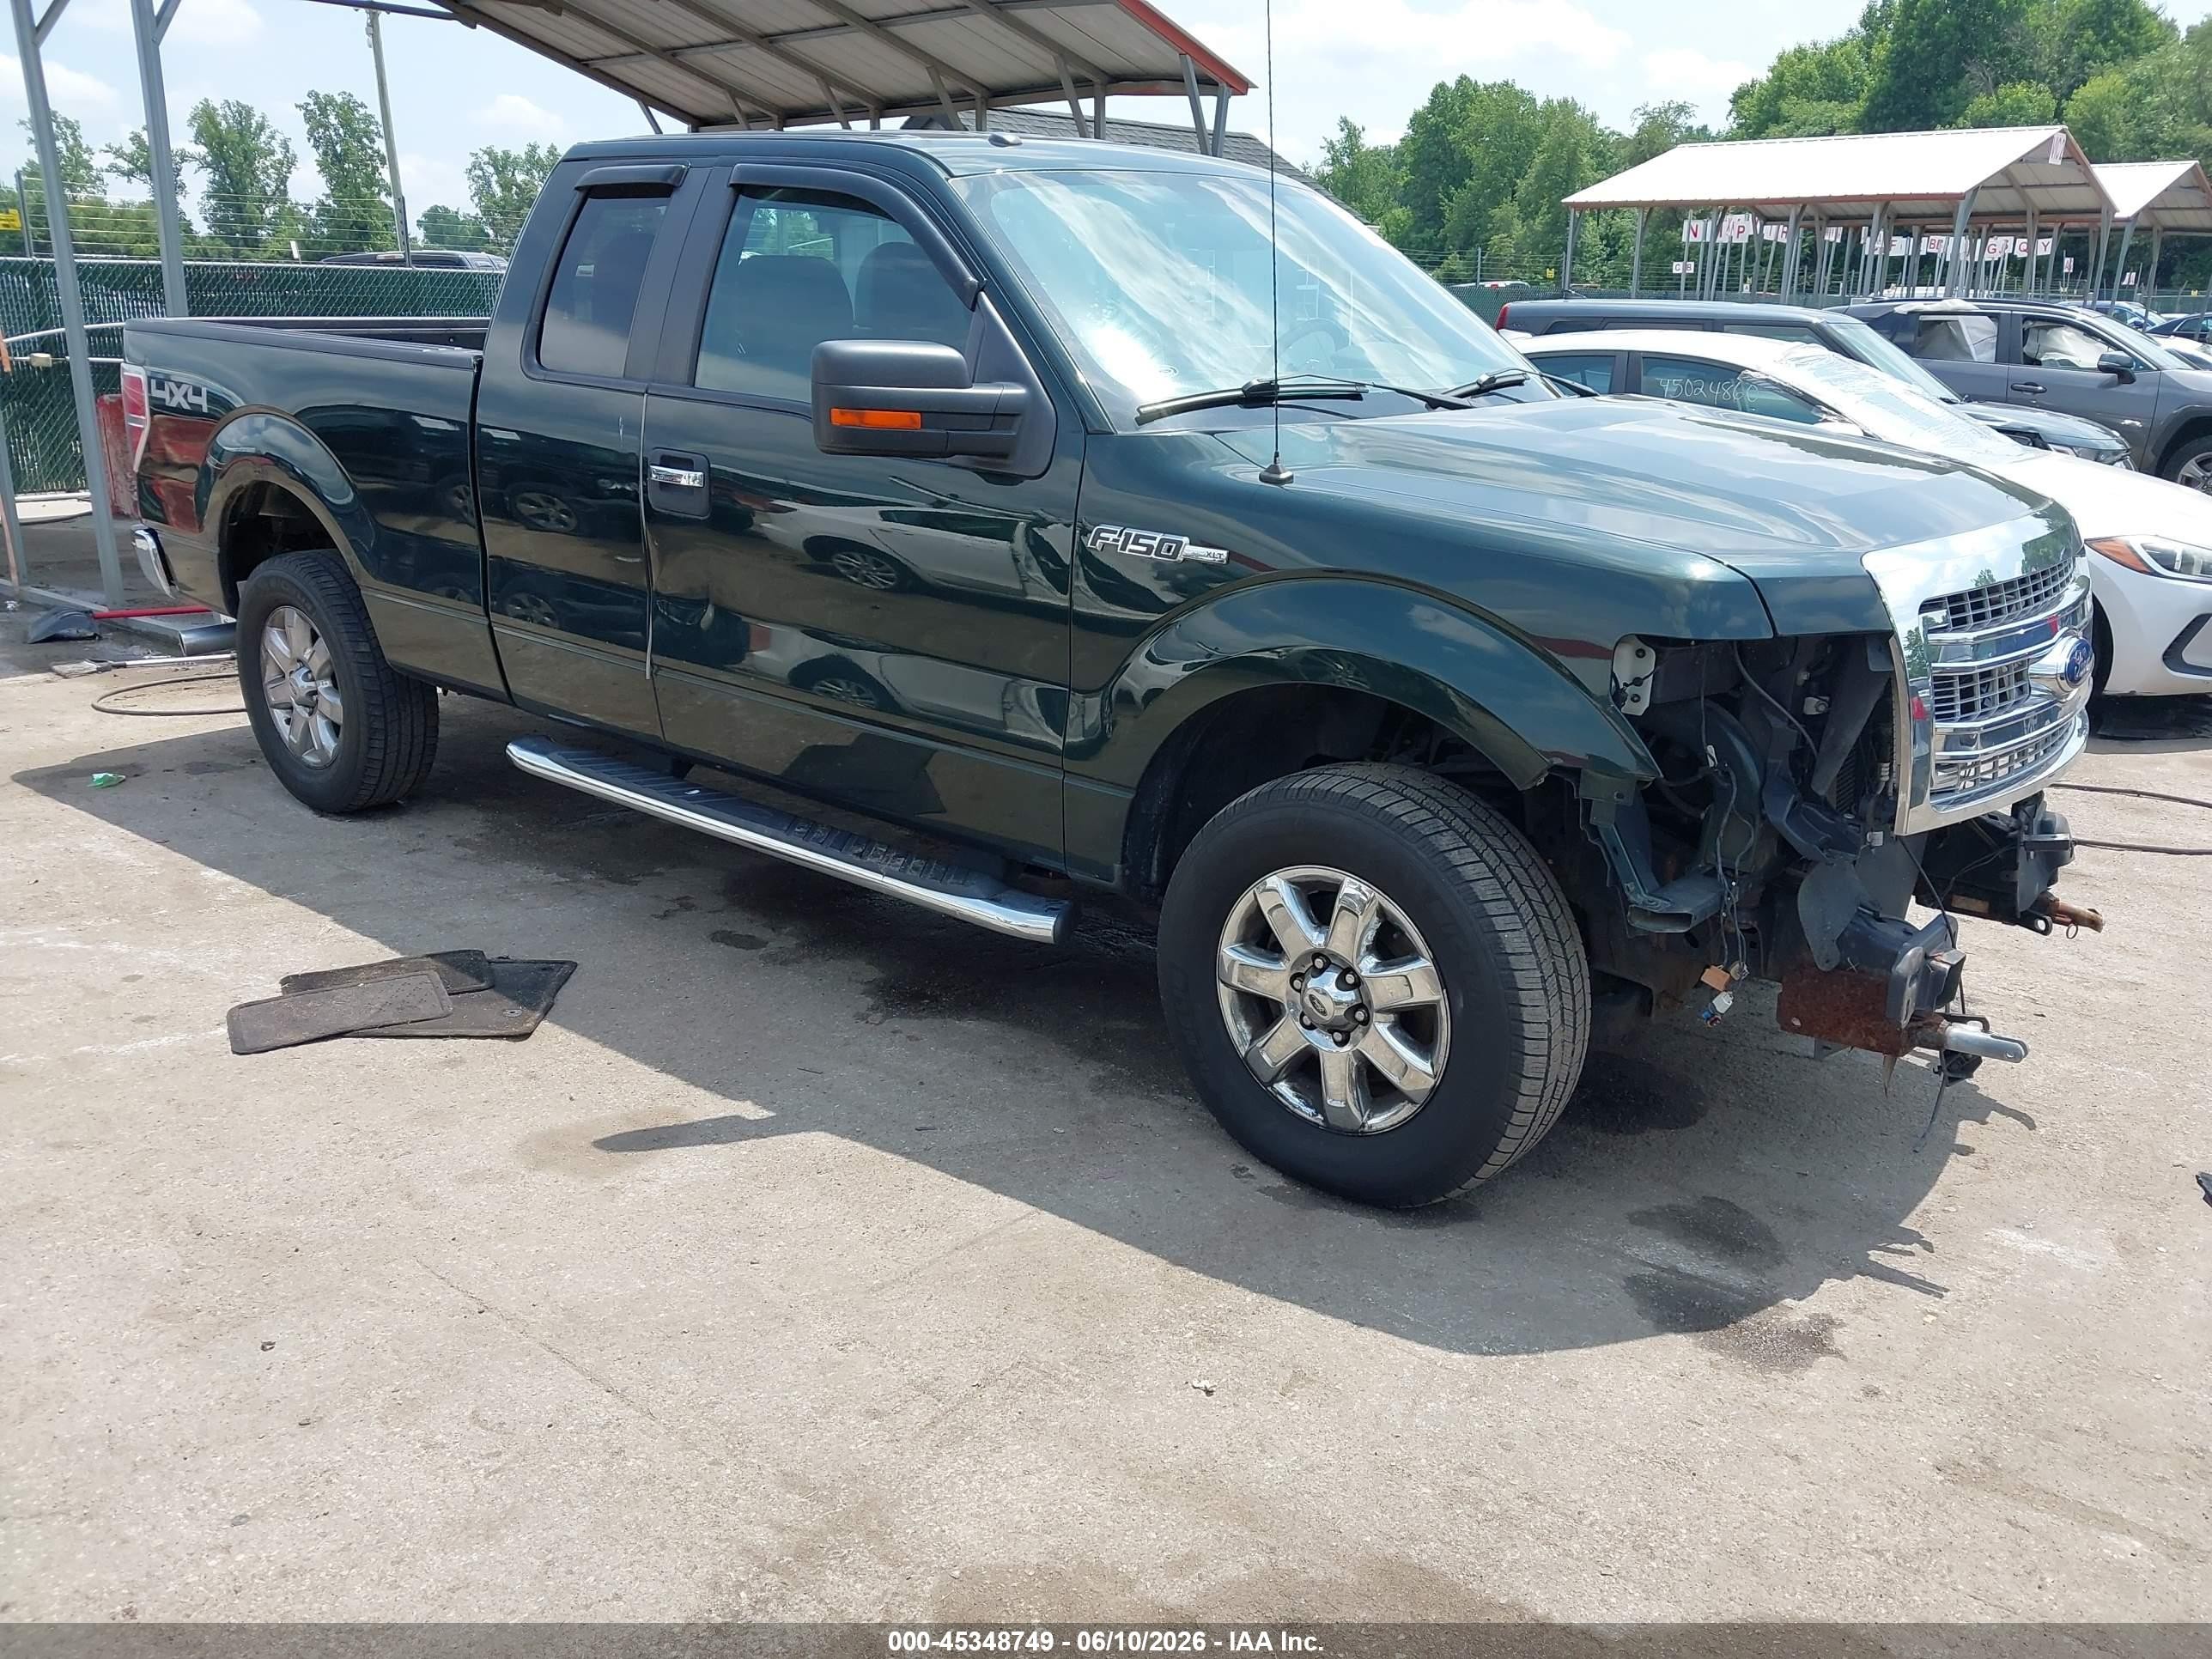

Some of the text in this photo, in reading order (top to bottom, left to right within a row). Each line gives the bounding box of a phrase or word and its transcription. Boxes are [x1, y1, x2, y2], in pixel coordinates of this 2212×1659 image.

[1736, 225, 1746, 239] P
[1987, 243, 1997, 254] G
[2019, 241, 2028, 252] Q
[2041, 241, 2050, 252] Y
[1087, 524, 1224, 563] F-150 XLT
